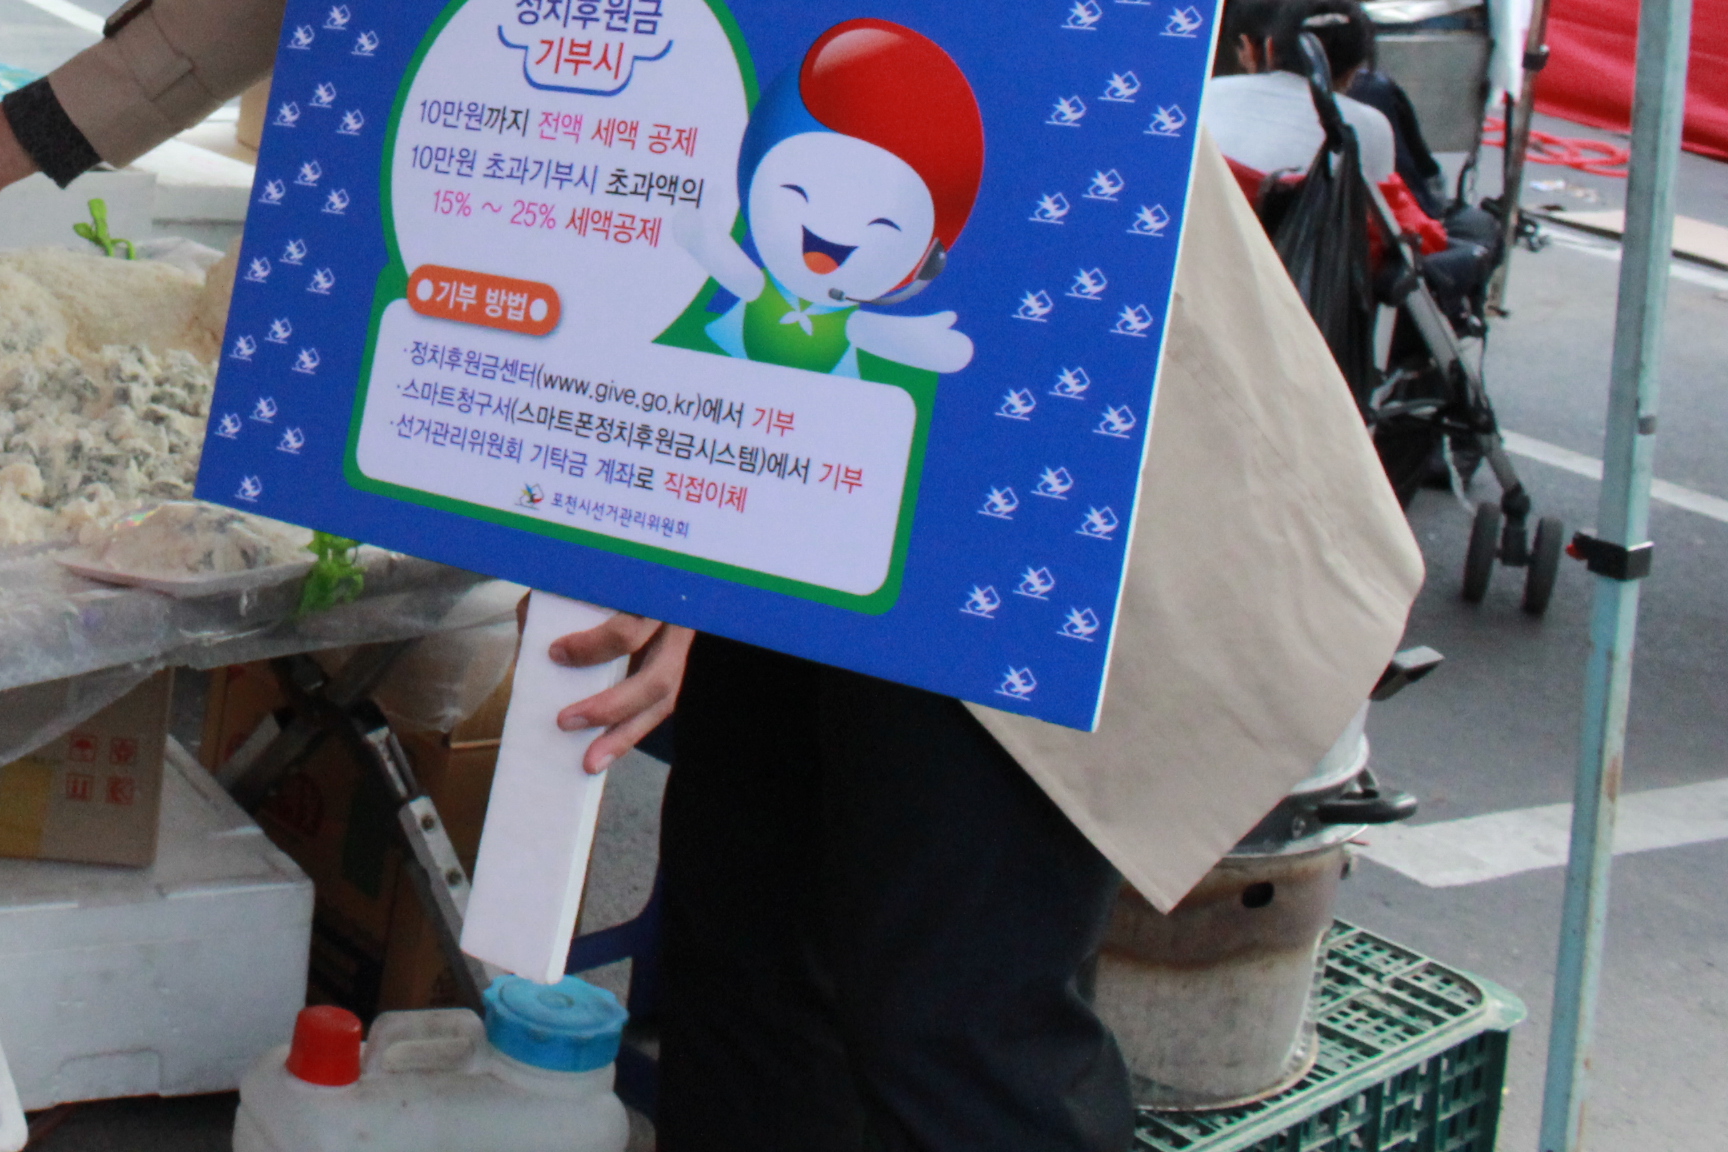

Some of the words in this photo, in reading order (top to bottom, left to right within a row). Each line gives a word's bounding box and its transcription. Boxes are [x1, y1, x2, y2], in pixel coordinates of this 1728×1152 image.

[535, 36, 625, 79] 기부시
[420, 99, 529, 137] 10만원까지
[538, 110, 583, 143] 전액
[591, 117, 639, 149] 세액
[648, 123, 698, 157] 공제
[411, 145, 475, 178] 10만원
[483, 153, 598, 195] 초과기부시
[605, 168, 704, 208] 초과액의
[433, 189, 472, 217] 15%
[510, 199, 556, 230] 25%
[565, 207, 662, 248] 세액공제
[435, 281, 477, 311] 기부
[485, 288, 528, 321] 방법
[752, 406, 795, 437] 기부
[530, 443, 588, 478] 기탁금
[595, 458, 654, 491] 계좌로
[664, 471, 748, 513] 직접이체
[819, 462, 864, 494] 기부
[551, 491, 690, 538] 포천시선거관리위원회
